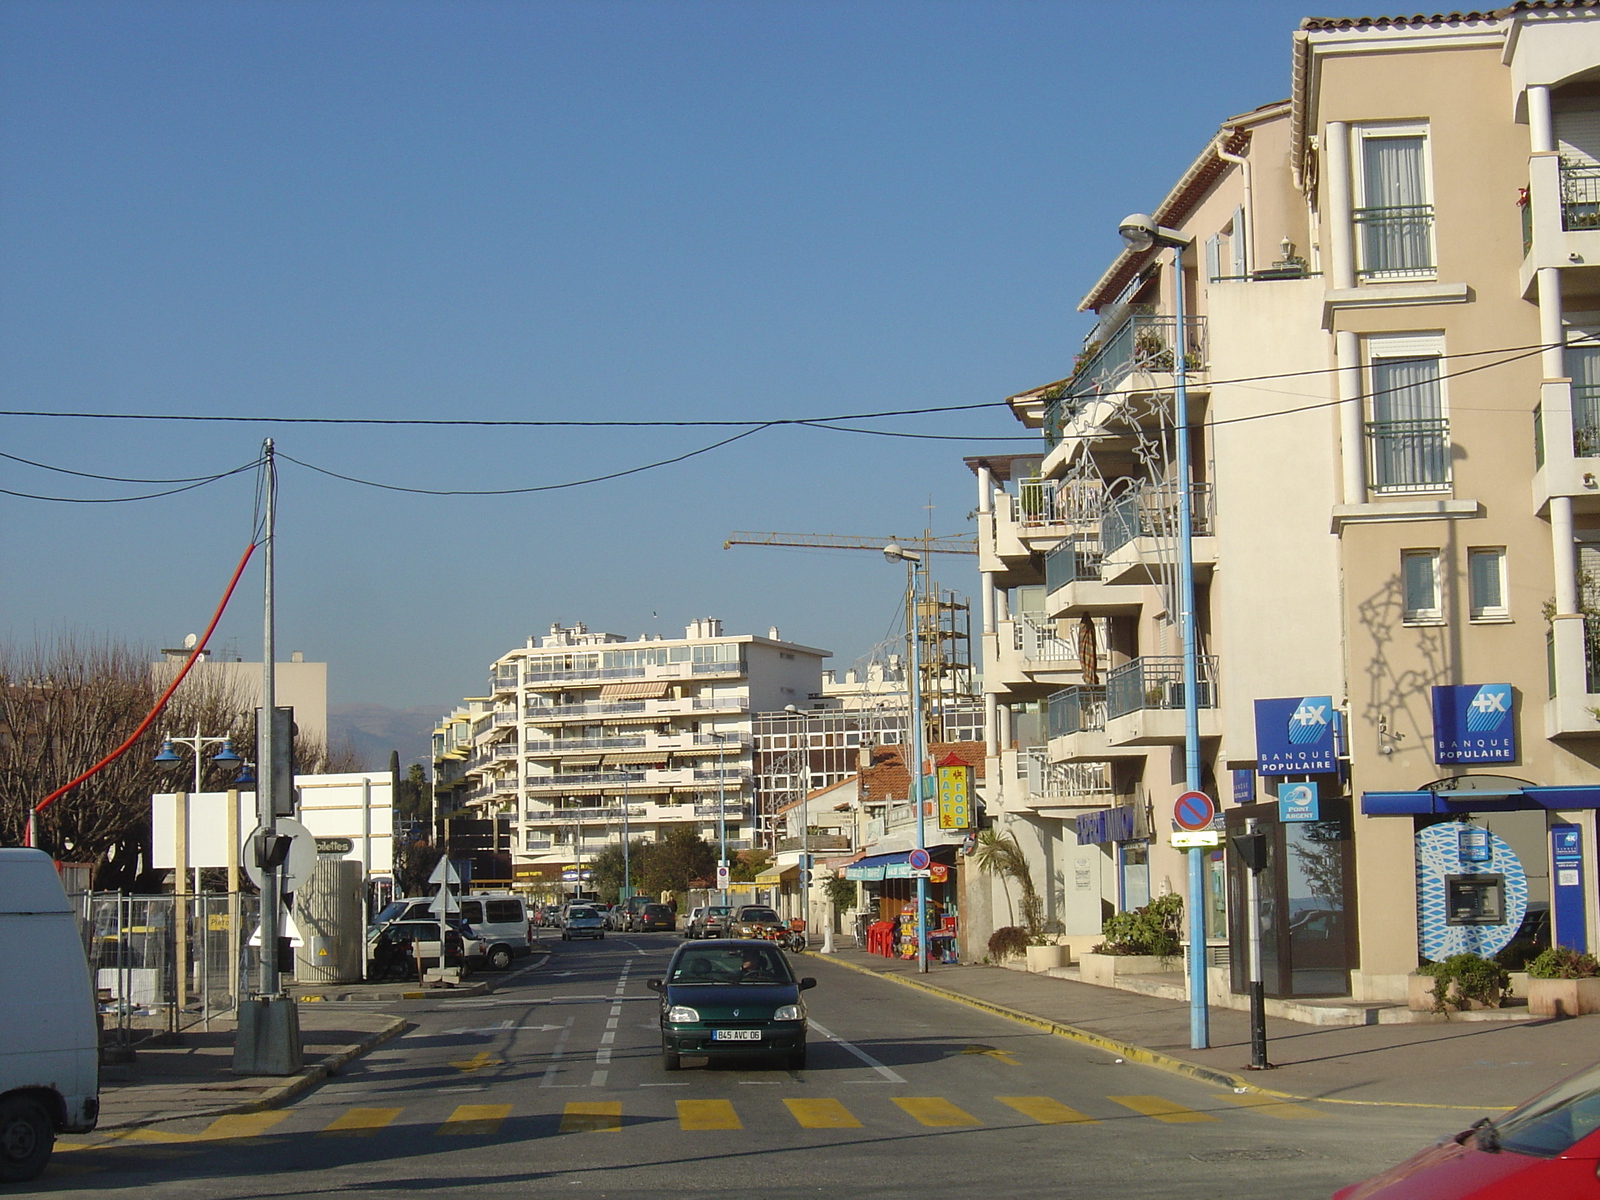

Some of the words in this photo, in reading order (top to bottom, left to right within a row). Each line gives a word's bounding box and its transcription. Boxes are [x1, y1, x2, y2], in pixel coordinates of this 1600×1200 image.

[1439, 738, 1509, 749] BANQUE
[1261, 750, 1330, 761] BANQUE
[1440, 749, 1510, 759] POPULAIRE
[1262, 761, 1331, 771] POPULAIRE
[942, 769, 950, 813] FAST
[955, 783, 964, 826] FOOD
[316, 840, 349, 851] oilettes
[718, 1031, 732, 1039] 845
[734, 1031, 748, 1039] AVC
[750, 1031, 760, 1039] 06
